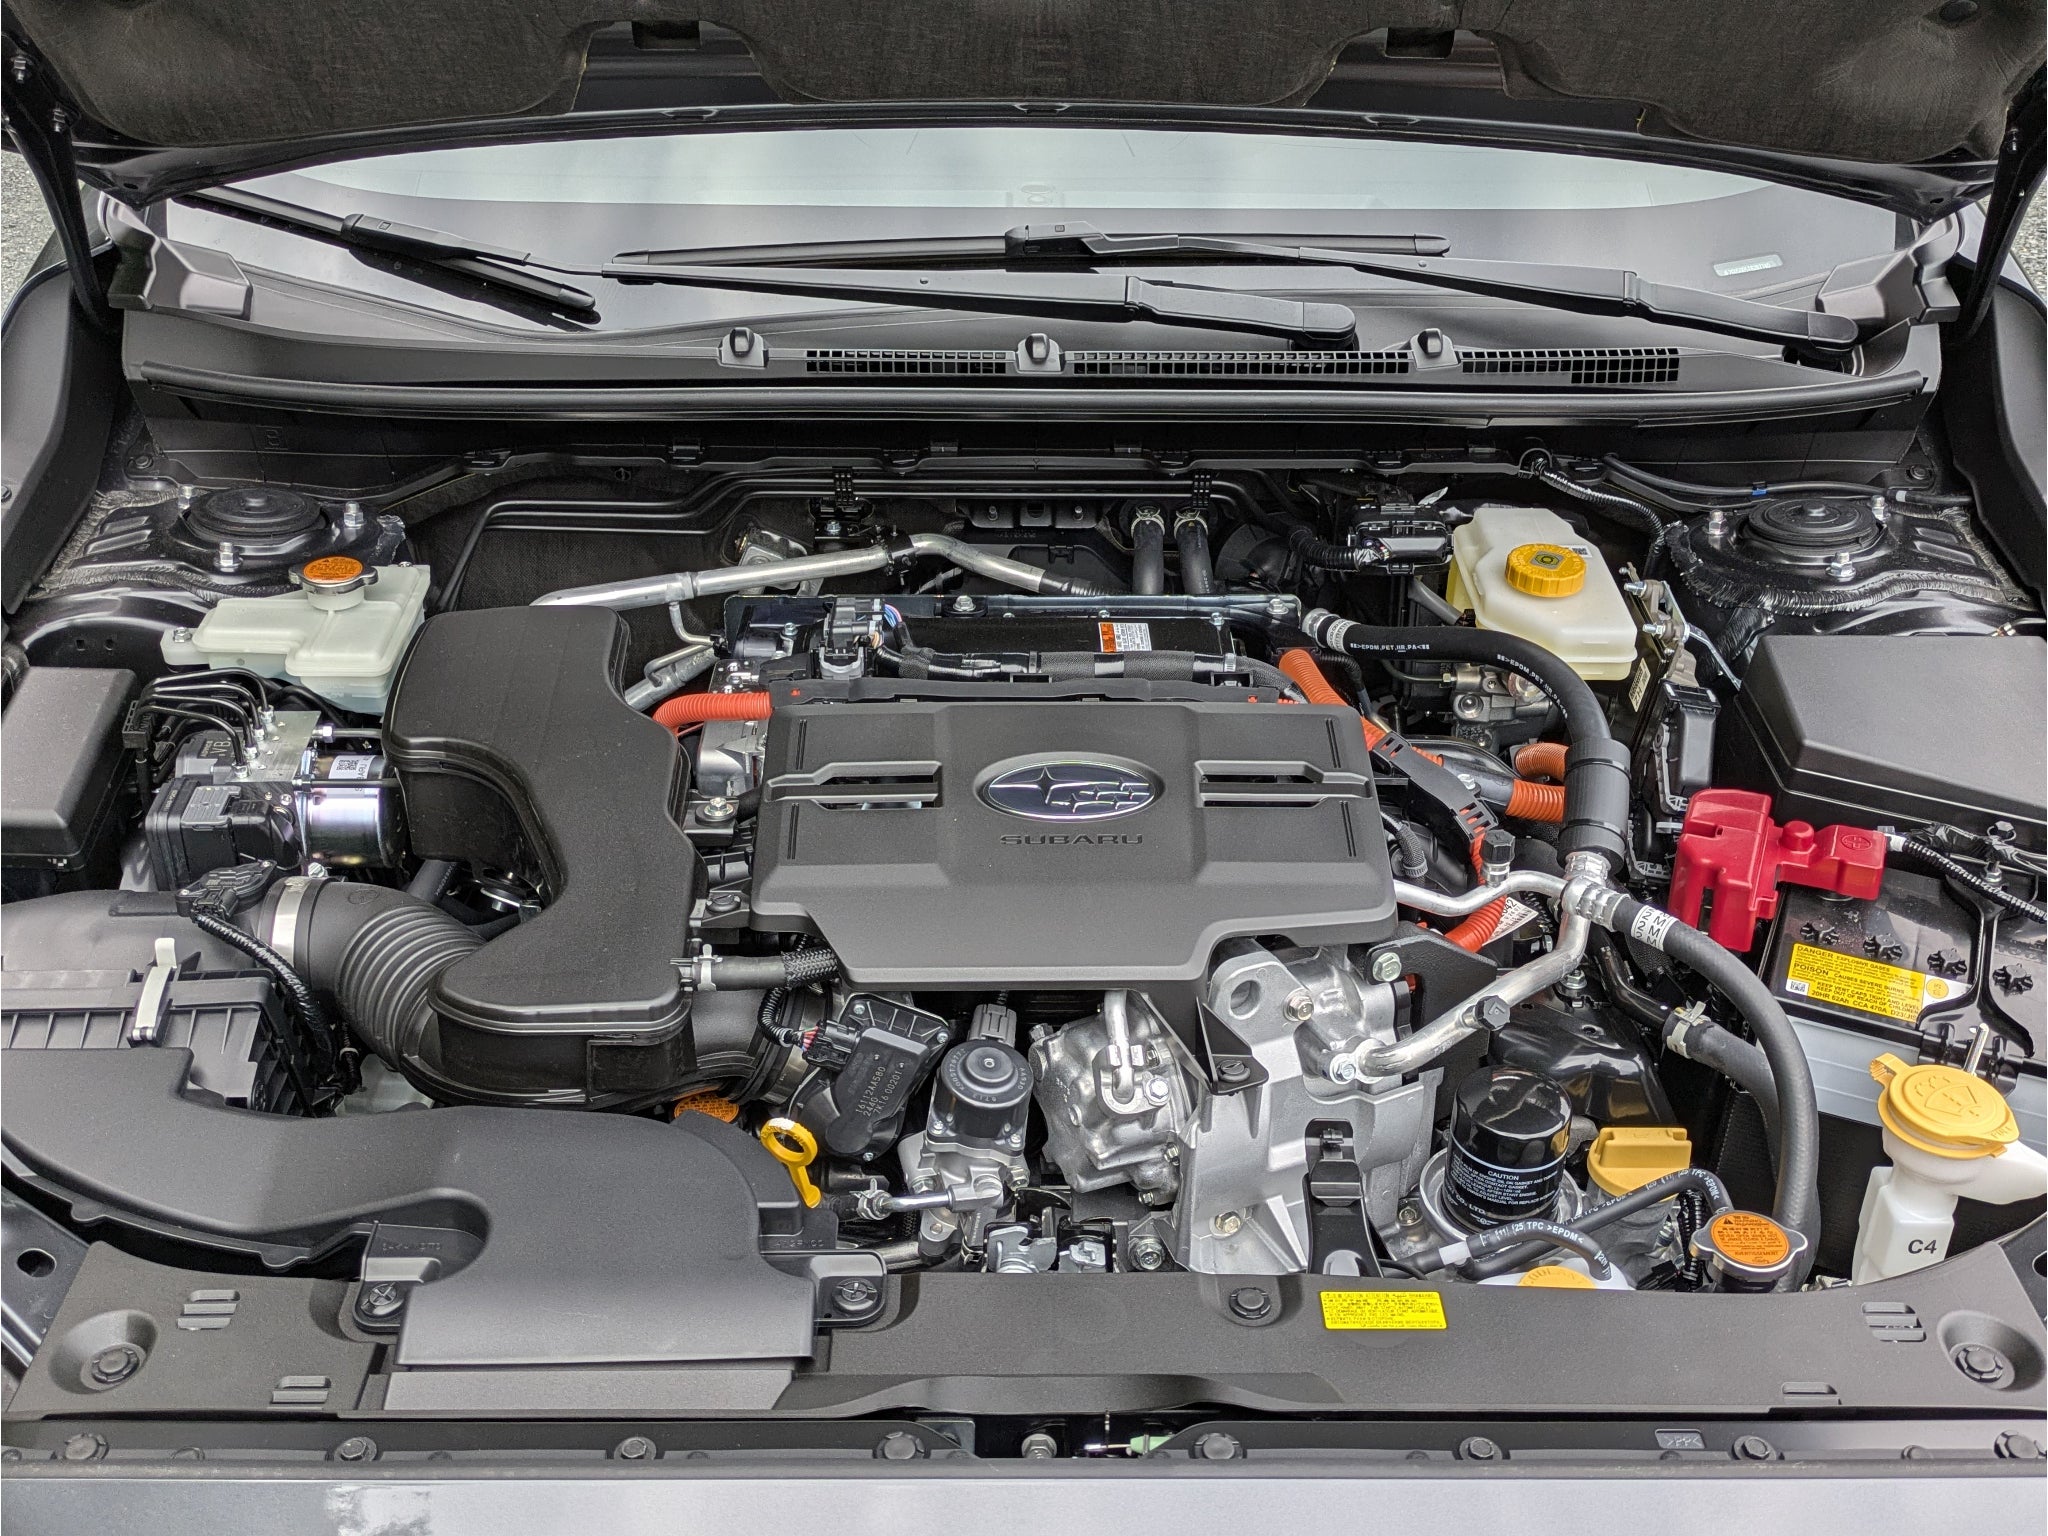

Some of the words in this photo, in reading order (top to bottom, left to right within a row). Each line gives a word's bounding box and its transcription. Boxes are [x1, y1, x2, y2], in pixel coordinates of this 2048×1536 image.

[1000, 833, 1143, 845] SUBARU
[1797, 946, 1834, 959] DANGER
[1836, 956, 1868, 967] EXPLOSIVE
[1794, 962, 1829, 976] POISON
[1834, 973, 1858, 983] CAUSES
[1834, 985, 1850, 993] VENT
[1851, 989, 1868, 998] CAPS
[1812, 990, 1830, 999] 20HR
[1832, 995, 1850, 1004] 62Ah
[1852, 1000, 1868, 1010] CCA
[1870, 1004, 1888, 1014] 470A
[1856, 996, 1878, 1005] REACH
[1488, 1170, 1520, 1180] CAUTION
[1526, 1221, 1544, 1230] TPC
[1546, 1224, 1584, 1244] >EPDM<
[1908, 1239, 1938, 1254] C4
